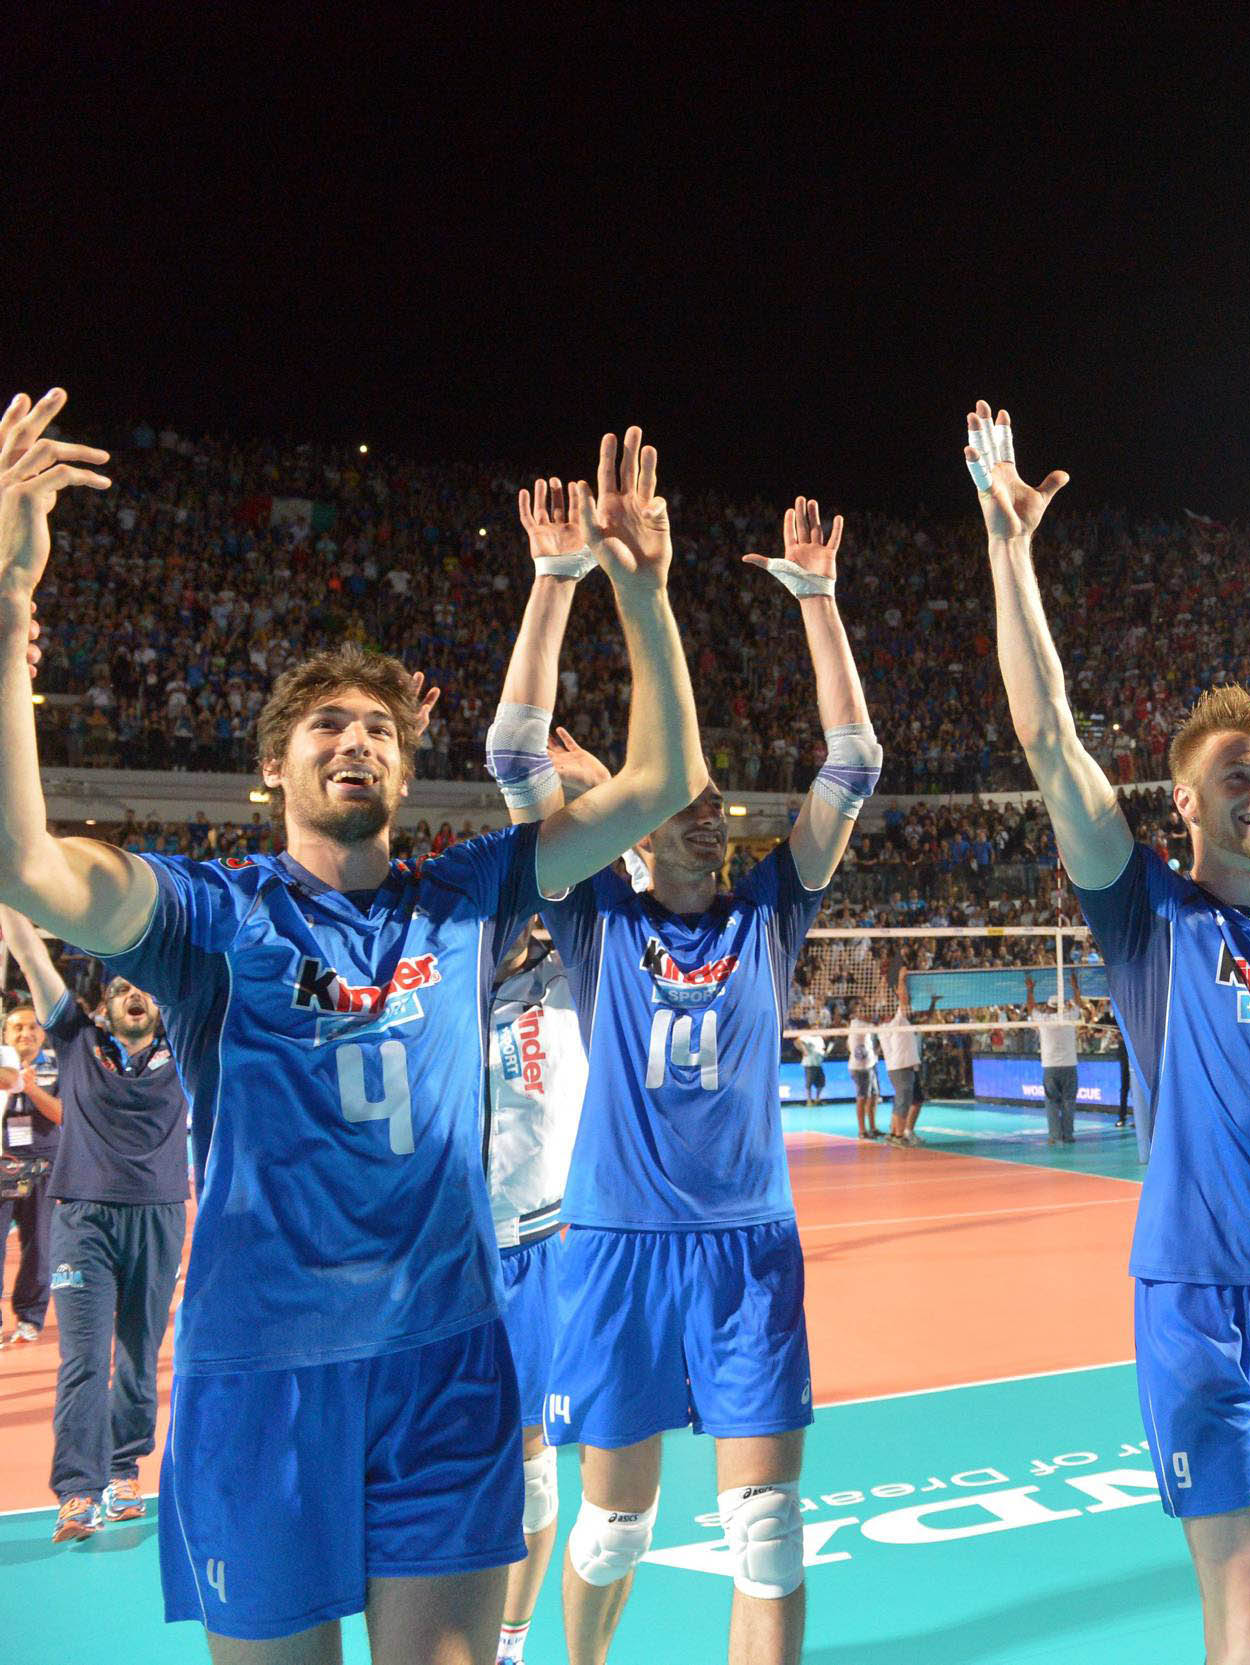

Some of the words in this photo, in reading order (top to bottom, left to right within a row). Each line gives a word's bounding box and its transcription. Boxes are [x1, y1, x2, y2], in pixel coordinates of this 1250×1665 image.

[518, 1010, 545, 1094] inder
[645, 1009, 718, 1090] 14
[336, 1040, 415, 1155] 4
[549, 1393, 571, 1425] 14
[1030, 1451, 1099, 1477] of
[1173, 1452, 1192, 1488] 9
[694, 1466, 1010, 1527] Dreas
[206, 1558, 227, 1603] 4
